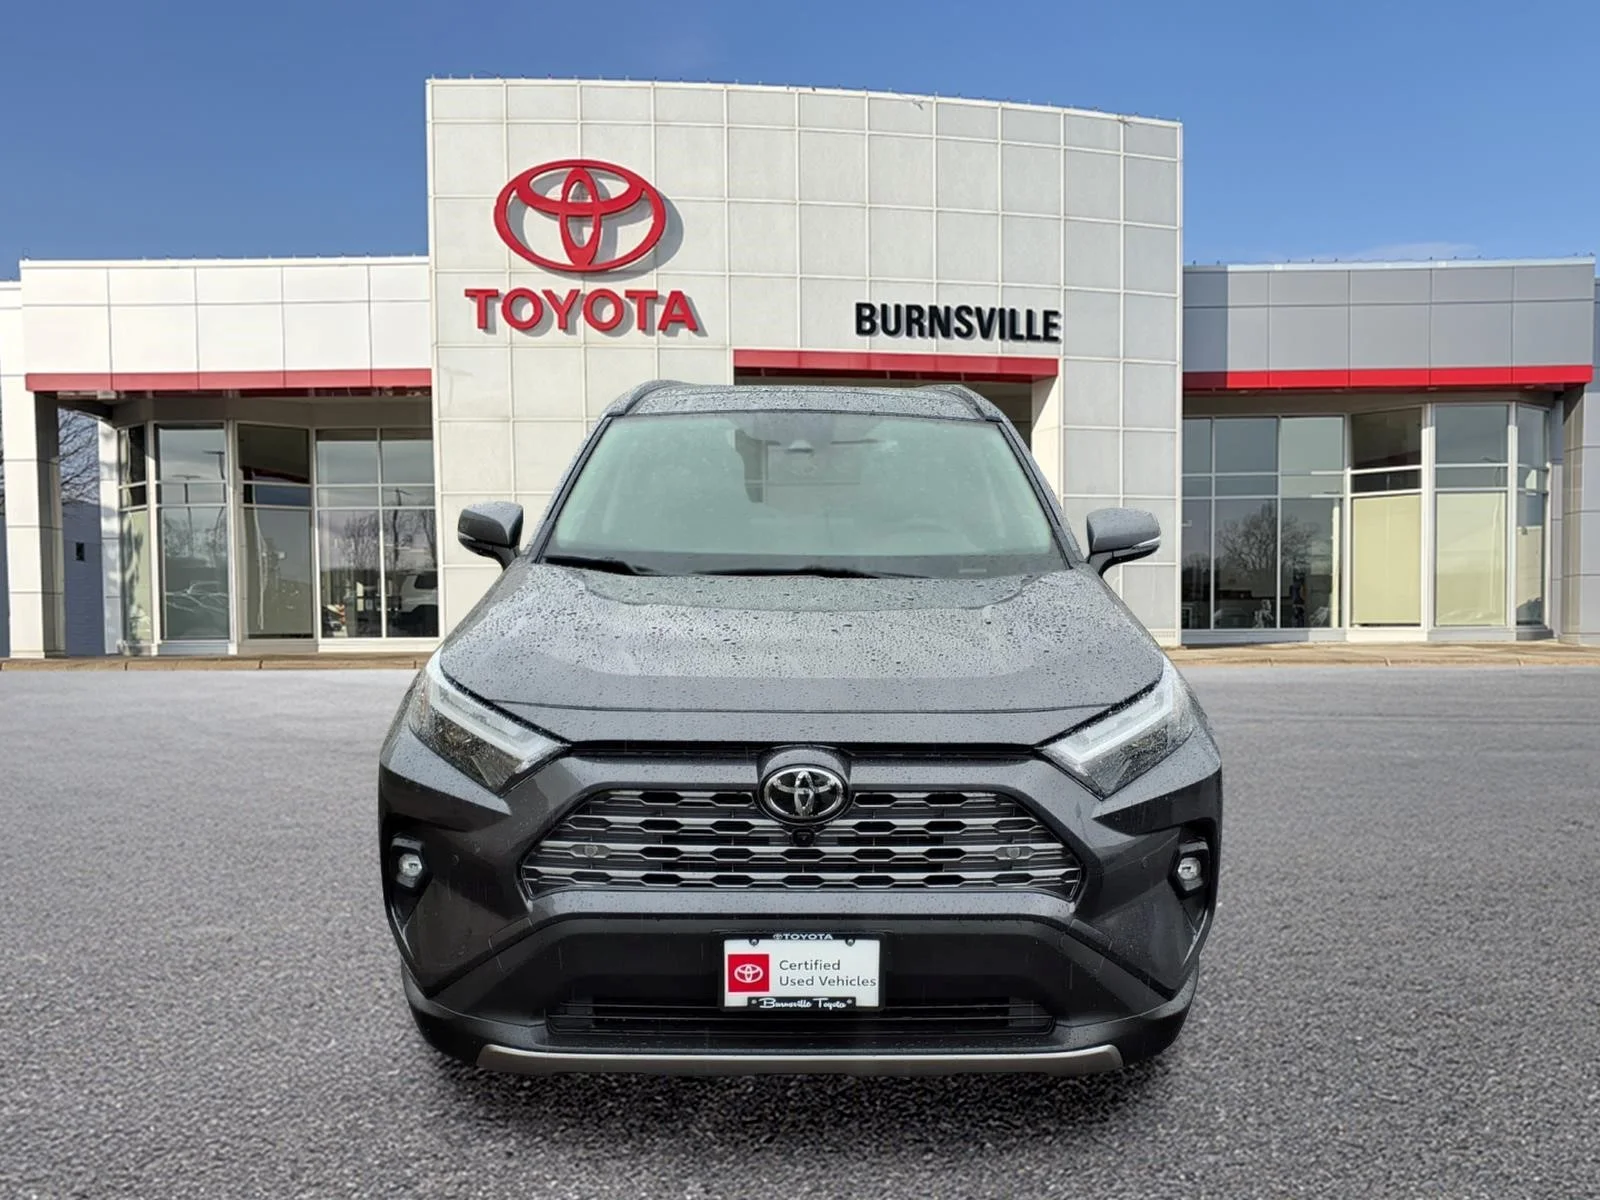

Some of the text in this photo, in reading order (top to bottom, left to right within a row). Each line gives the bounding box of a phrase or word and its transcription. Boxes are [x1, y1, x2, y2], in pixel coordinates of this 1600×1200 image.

[465, 288, 699, 332] TOYOTA
[855, 302, 1061, 342] BURNSVILLE
[779, 959, 841, 971] Certified
[779, 975, 877, 987] Used Vehicles
[758, 997, 847, 1010] Burnsville Toyota
